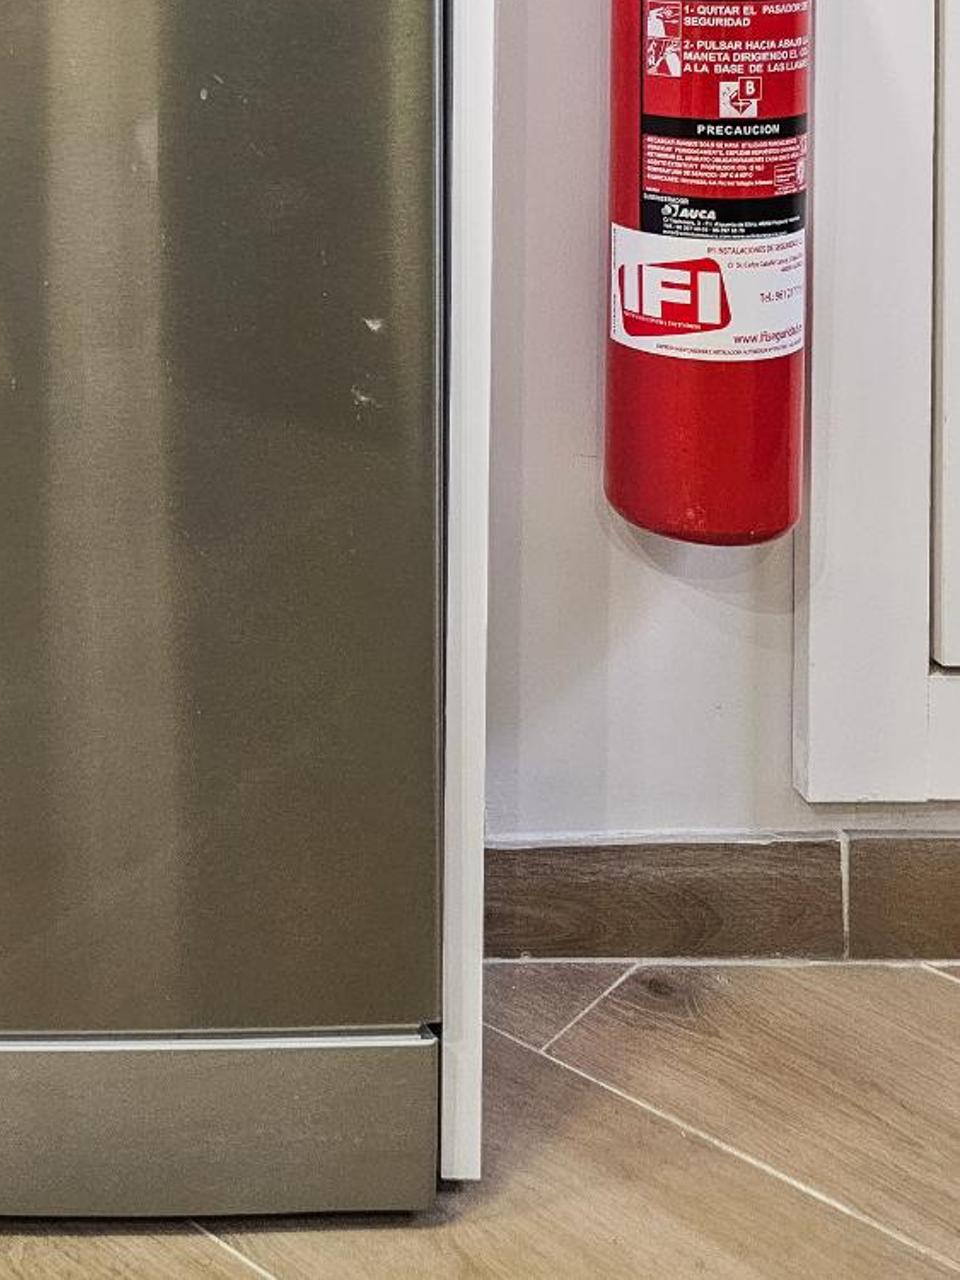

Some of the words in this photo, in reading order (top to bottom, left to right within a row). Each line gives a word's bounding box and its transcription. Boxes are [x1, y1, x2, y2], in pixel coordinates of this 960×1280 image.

[697, 5, 741, 16] QUITAR
[743, 5, 757, 15] EL
[683, 17, 751, 27] SEGURIDAD
[697, 40, 742, 51] PULSAR
[745, 39, 776, 50] HACIA
[683, 51, 730, 62] MANETA
[683, 63, 692, 73] A
[694, 64, 709, 74] LA
[714, 64, 745, 74] BASE
[749, 64, 764, 74] DE
[767, 62, 785, 73] LAS
[746, 81, 756, 95] B
[697, 123, 780, 136] PRECAUCION
[679, 207, 717, 221] AUCA
[623, 263, 721, 325] IFI
